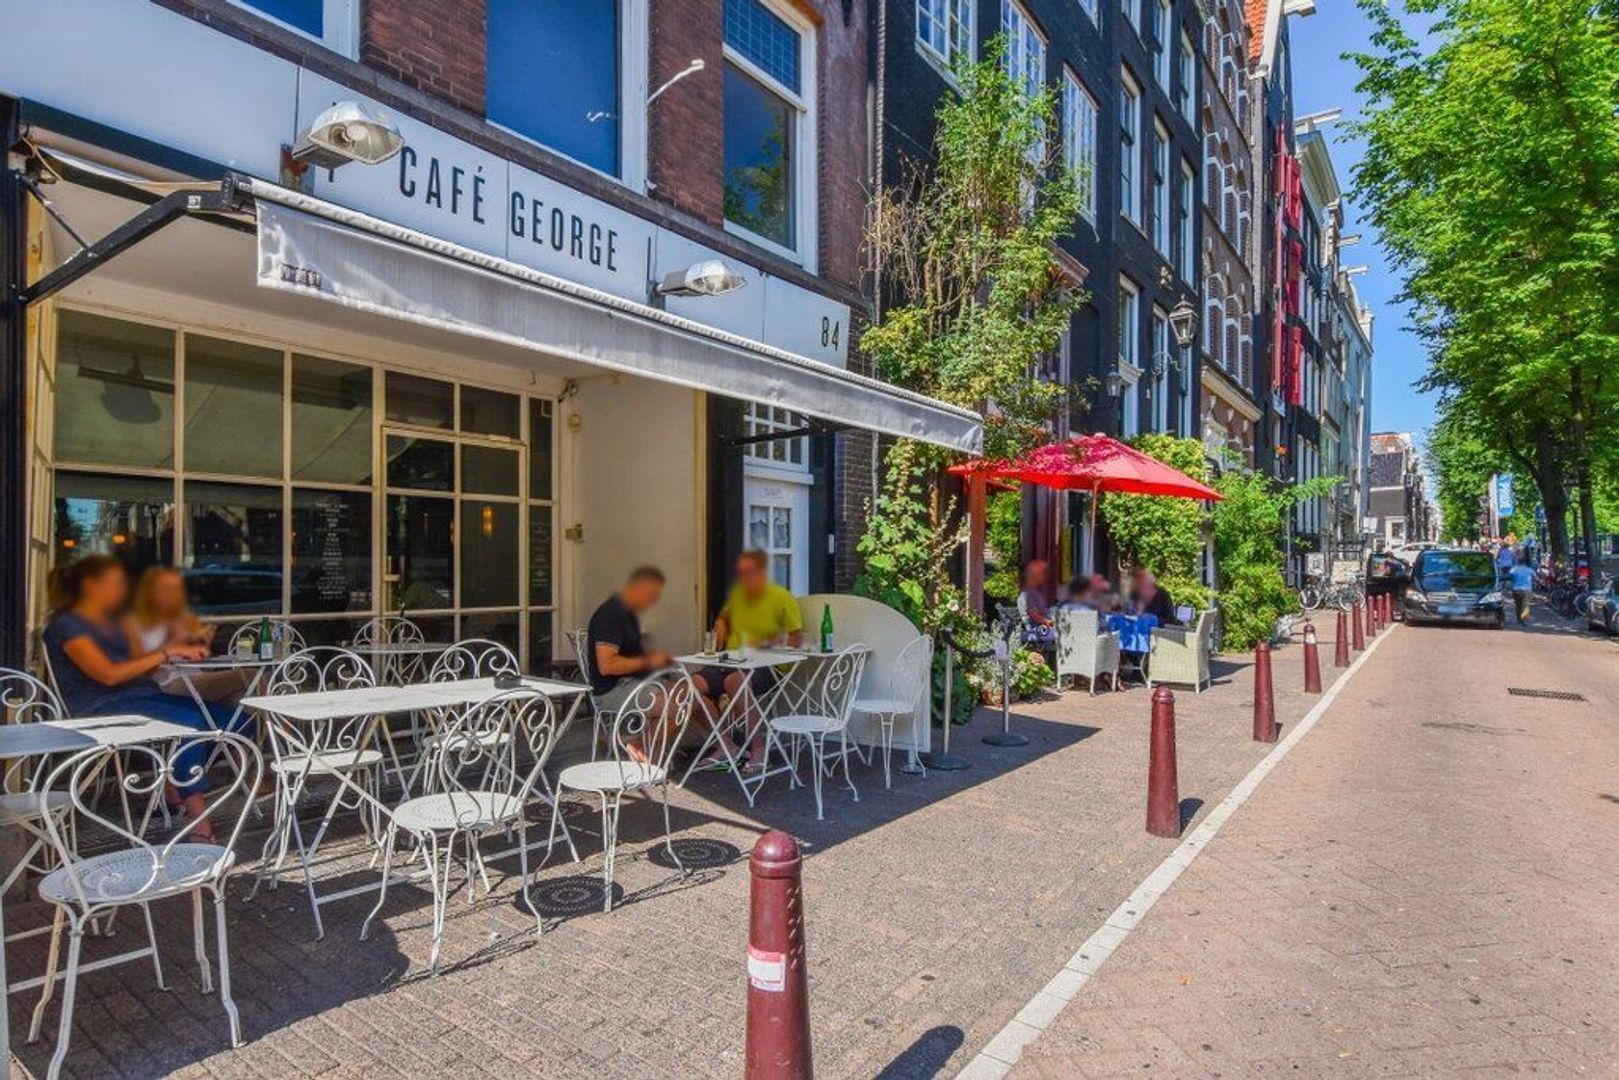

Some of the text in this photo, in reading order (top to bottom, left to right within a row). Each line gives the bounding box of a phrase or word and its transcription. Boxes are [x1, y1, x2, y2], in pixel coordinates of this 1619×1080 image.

[399, 145, 618, 273] CAFÉ GEORGE
[821, 316, 840, 351] 84
